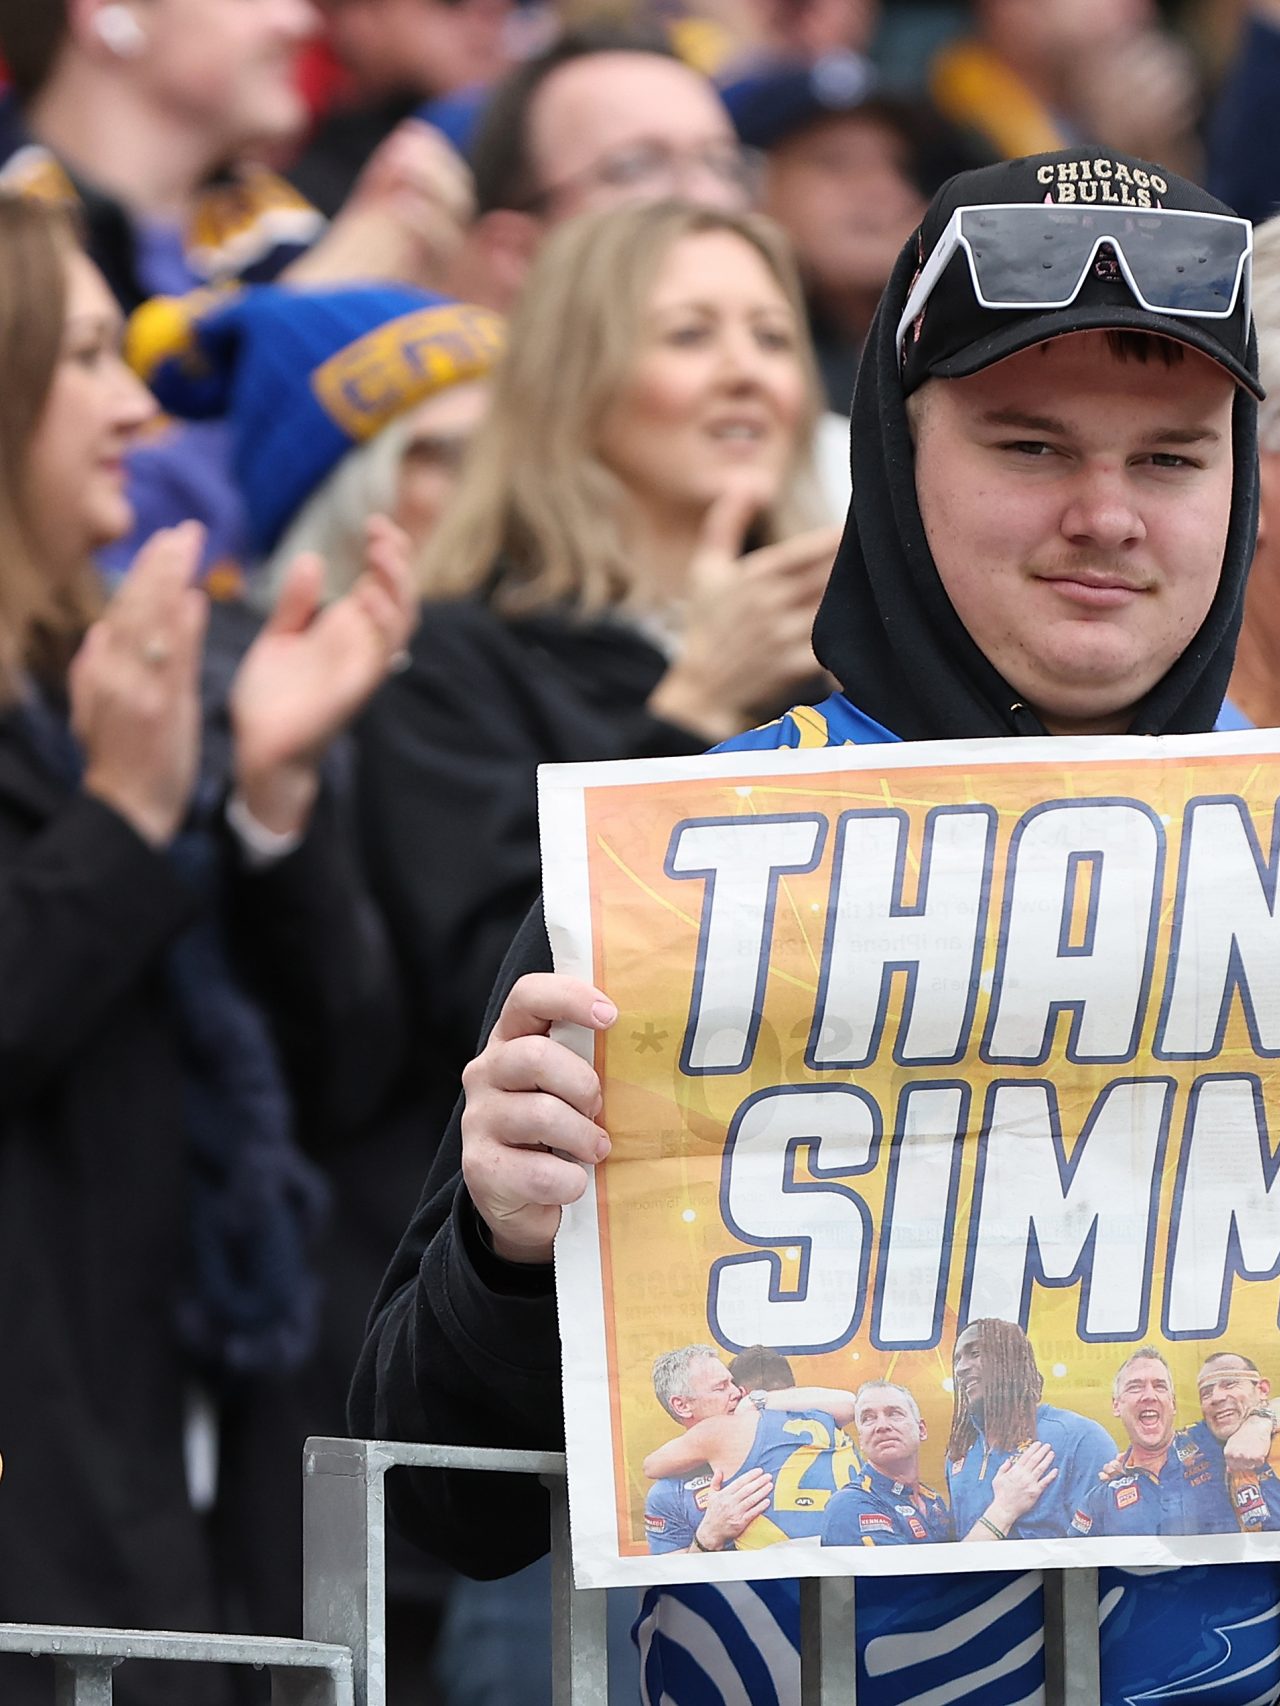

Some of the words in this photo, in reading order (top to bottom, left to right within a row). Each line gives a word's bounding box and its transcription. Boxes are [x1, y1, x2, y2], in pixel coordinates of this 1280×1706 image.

[1037, 158, 1168, 195] CHICAGO
[1057, 180, 1152, 208] BULLS
[1236, 1487, 1260, 1506] AFL
